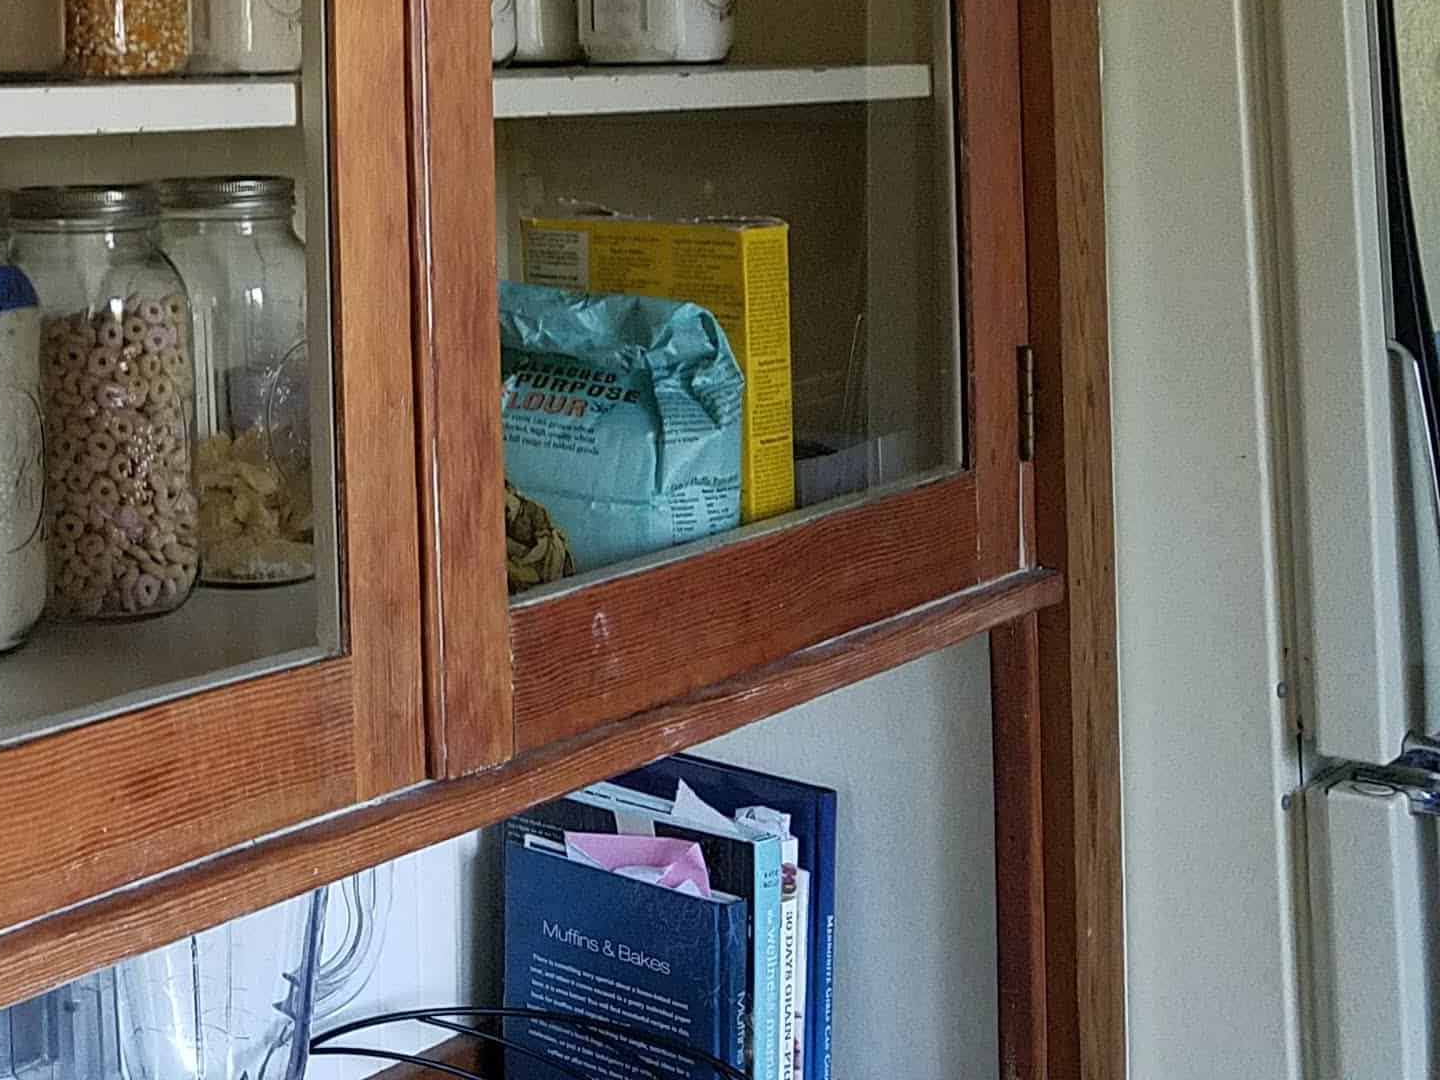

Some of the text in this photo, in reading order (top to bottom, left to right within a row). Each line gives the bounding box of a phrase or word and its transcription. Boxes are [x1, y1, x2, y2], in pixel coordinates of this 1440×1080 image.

[507, 391, 589, 418] LOUR
[514, 373, 641, 404] PURPOSE
[543, 920, 671, 975] Muffins & Bakes
[784, 935, 793, 981] DAYS
[784, 984, 793, 1080] GRAIN-FR
